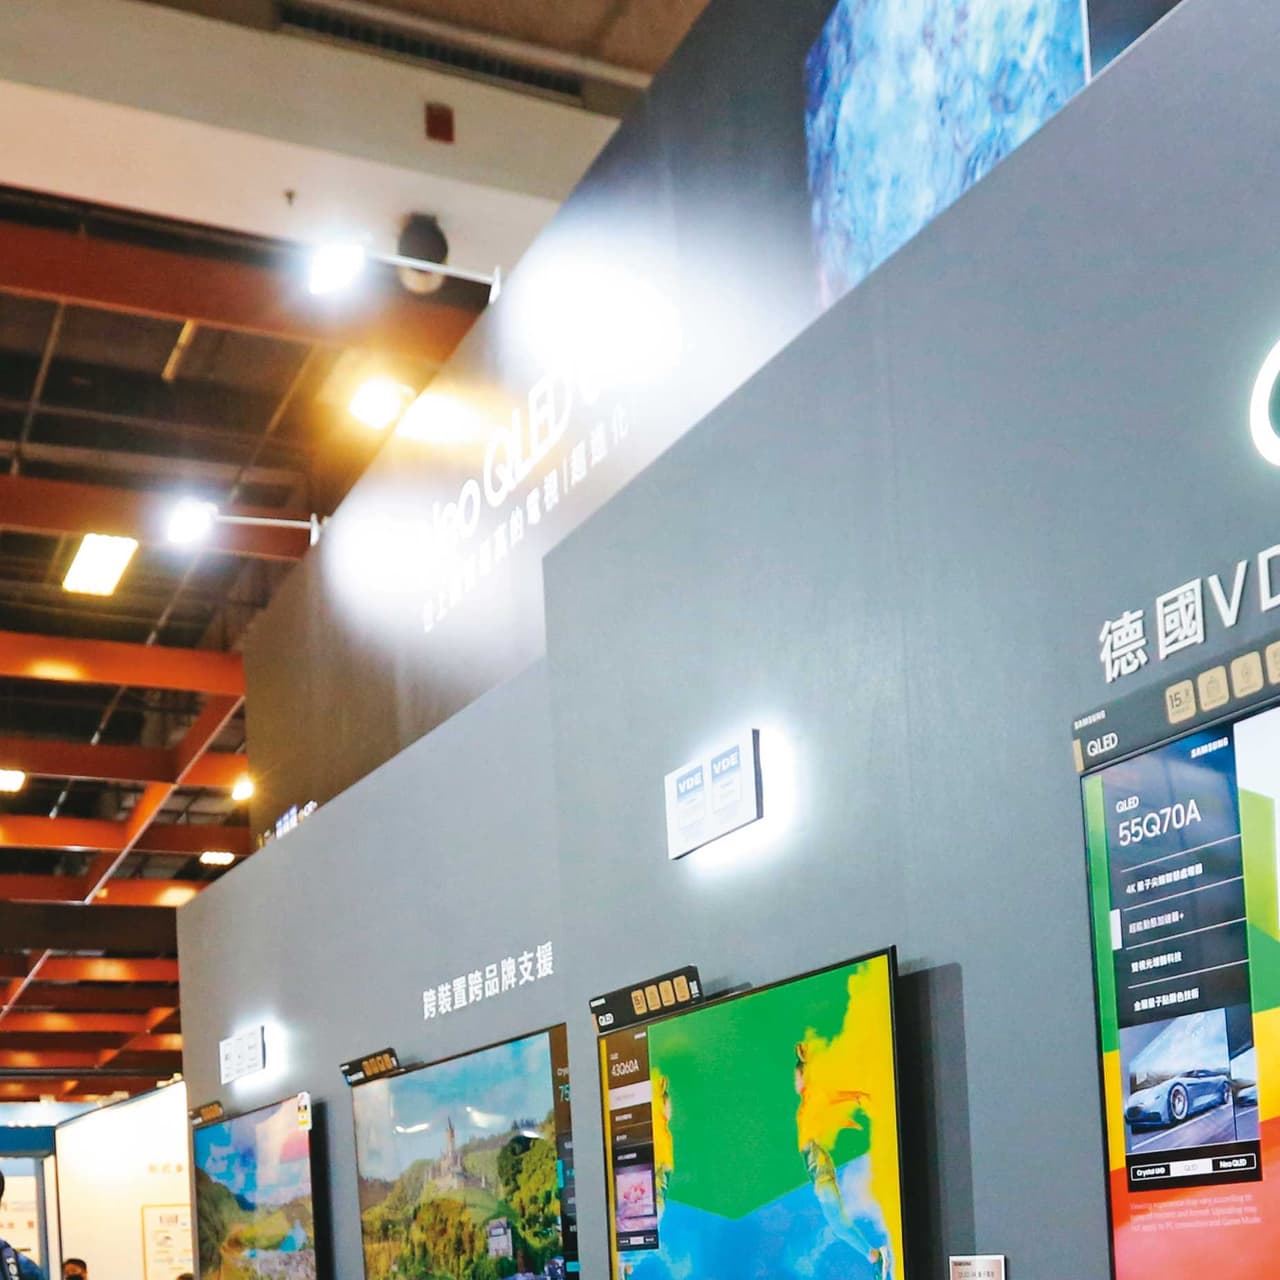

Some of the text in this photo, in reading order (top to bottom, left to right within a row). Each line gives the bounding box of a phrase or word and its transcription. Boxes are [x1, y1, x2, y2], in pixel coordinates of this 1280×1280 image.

[1087, 732, 1118, 757] QLED
[1190, 737, 1229, 758] SAMSUNG
[678, 752, 738, 793] VDE VDE
[1115, 795, 1139, 813] QLED
[1119, 799, 1202, 846] 55Q70A
[422, 940, 554, 1021] 跨裝置跨品牌支援
